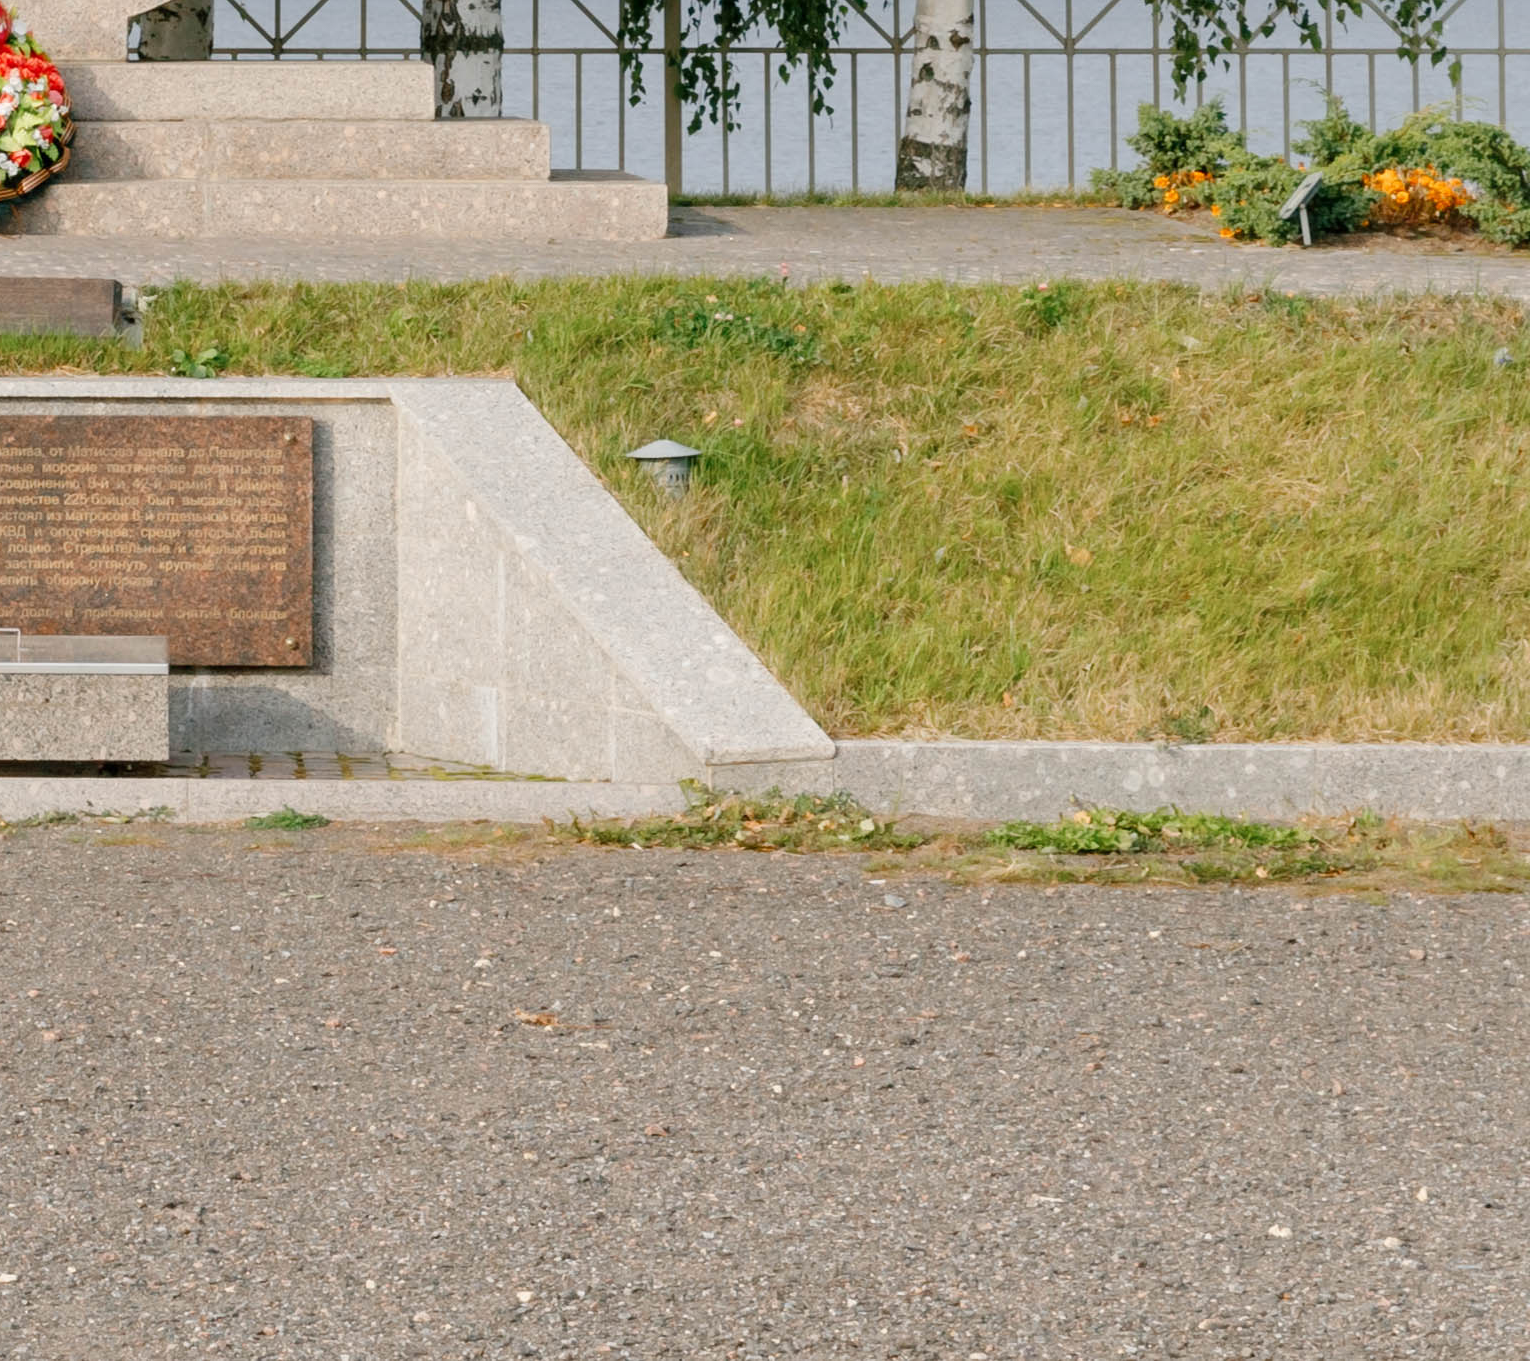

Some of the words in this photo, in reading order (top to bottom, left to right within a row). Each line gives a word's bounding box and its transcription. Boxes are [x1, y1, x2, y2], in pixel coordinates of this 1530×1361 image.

[137, 448, 184, 458] канала
[42, 464, 98, 476] морские
[106, 465, 186, 474] тактические
[193, 465, 251, 477] десанты
[258, 465, 284, 477] для
[63, 493, 88, 505] 225
[91, 494, 138, 509] бойцов
[147, 494, 174, 506] был
[182, 497, 241, 506] высажен
[157, 510, 228, 525] отдельной
[231, 510, 288, 525] бригады
[140, 529, 181, 541] среди
[187, 529, 242, 541] которых
[249, 526, 286, 538] были
[63, 543, 170, 558] Стремительные
[249, 545, 286, 555] атаки
[5, 560, 74, 570] заставили
[159, 561, 215, 574] крупные
[227, 561, 259, 571] силы
[47, 574, 101, 589] оборону
[83, 606, 163, 622] приблизили
[229, 606, 288, 622] блокады
